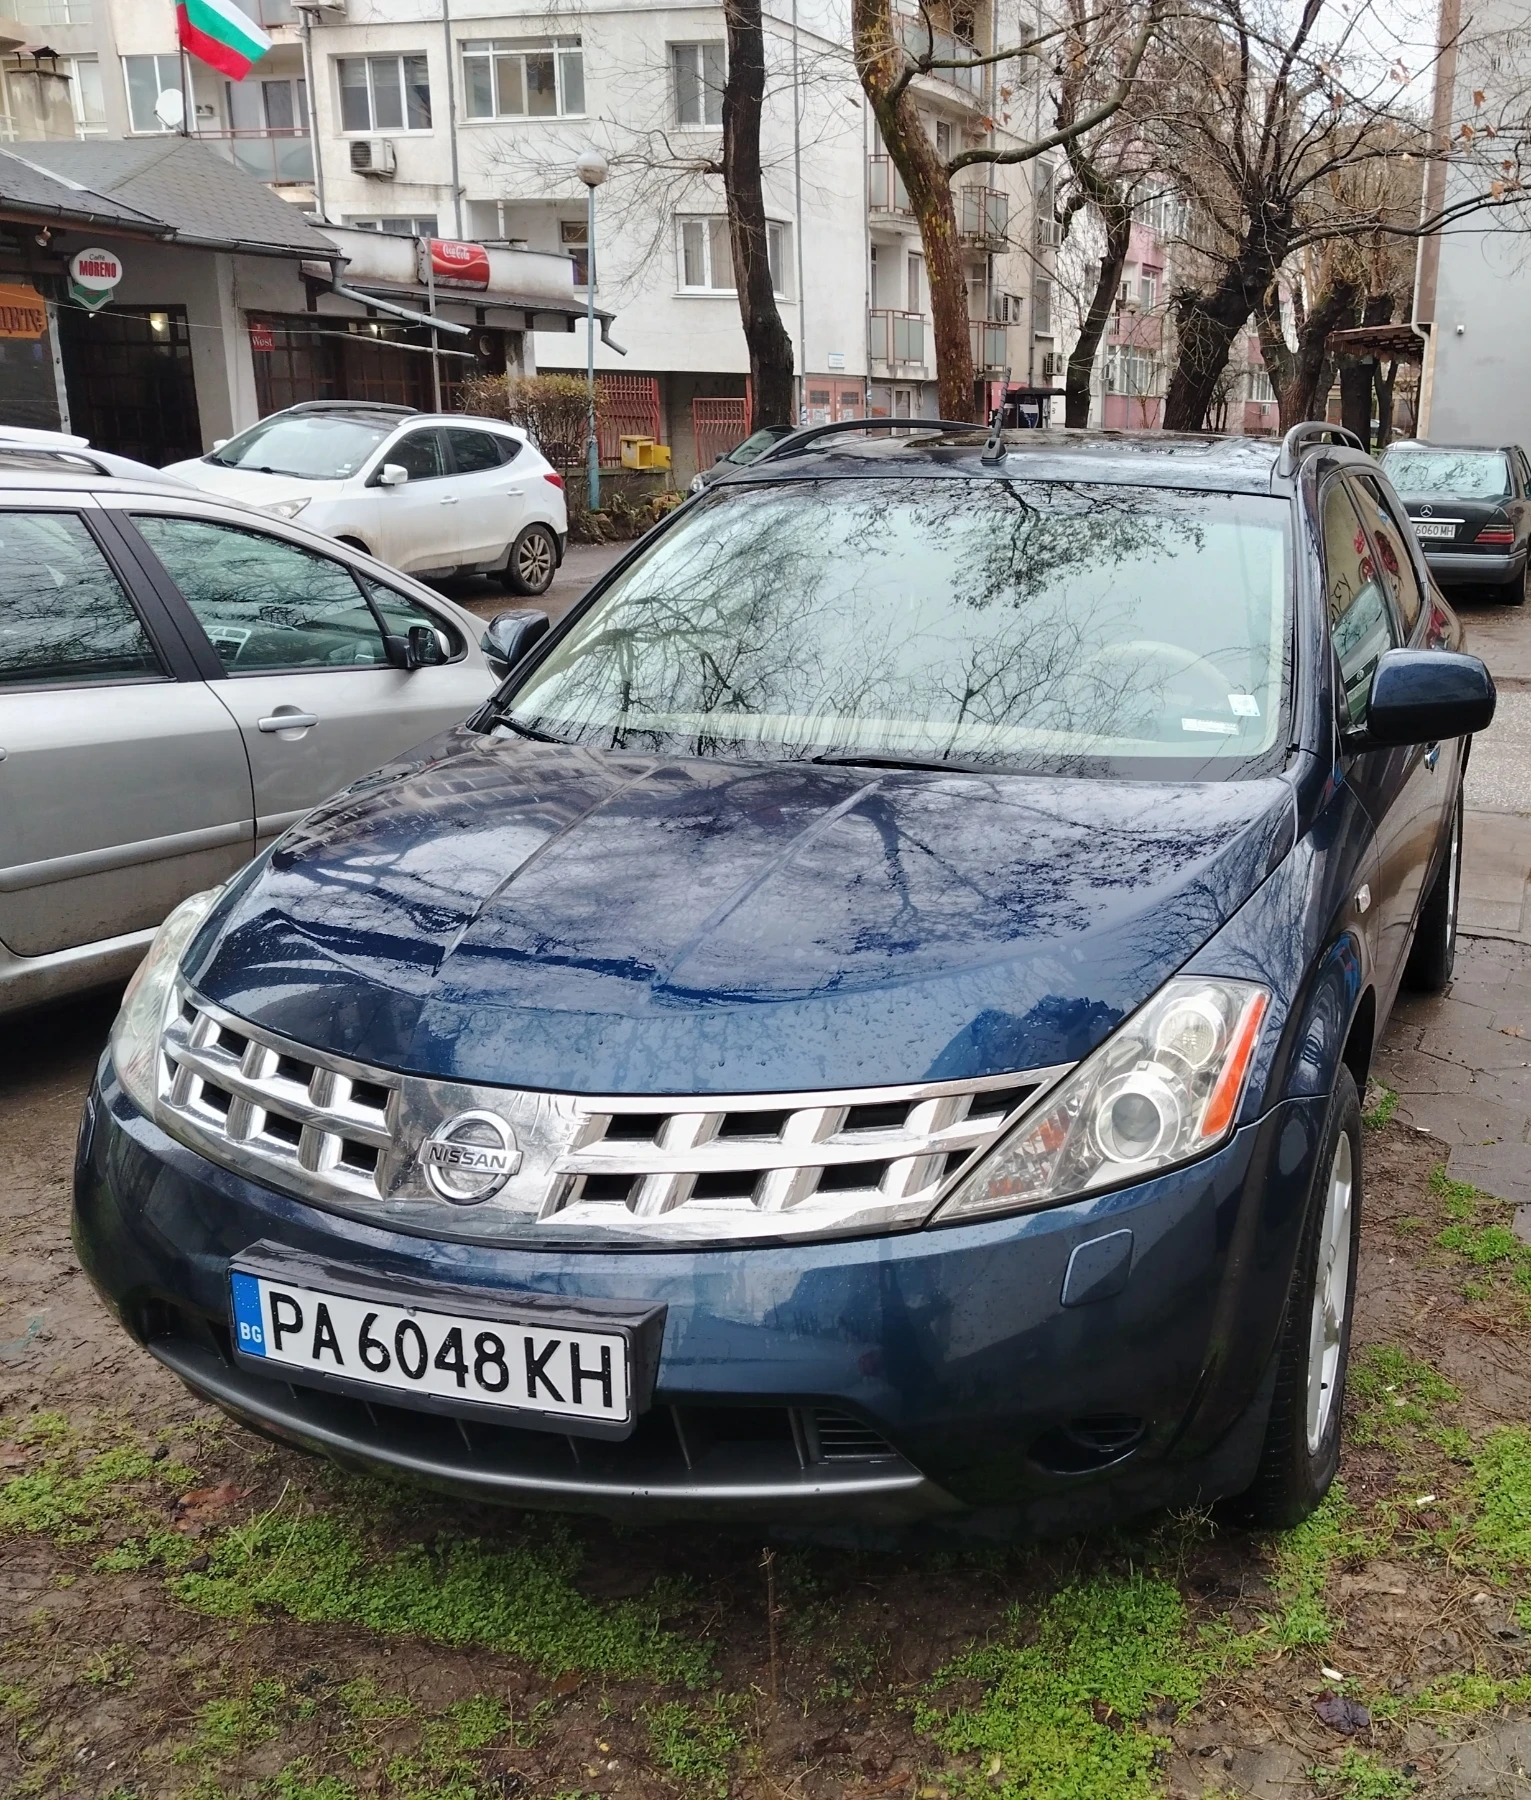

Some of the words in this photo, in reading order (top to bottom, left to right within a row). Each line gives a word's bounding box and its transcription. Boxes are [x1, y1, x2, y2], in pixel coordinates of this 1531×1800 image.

[79, 260, 117, 278] MORENO
[252, 336, 273, 347] West
[1415, 525, 1439, 536] 6060
[428, 1145, 508, 1170] NISSAN
[239, 1322, 263, 1344] BG
[268, 1290, 345, 1366] PA
[358, 1312, 510, 1393] 6048
[523, 1336, 613, 1408] KH
